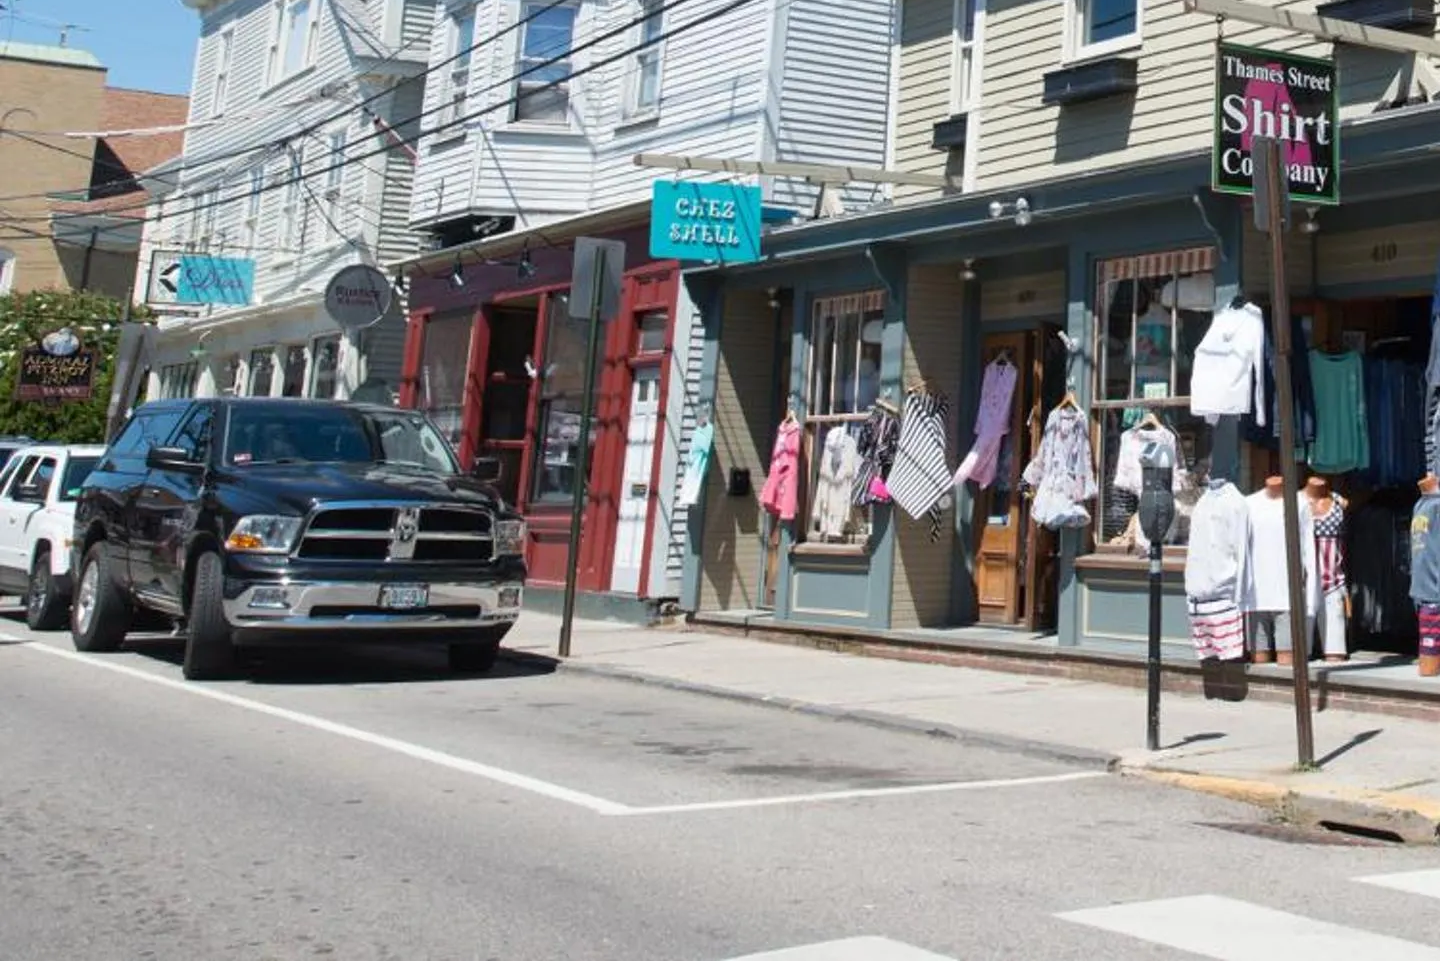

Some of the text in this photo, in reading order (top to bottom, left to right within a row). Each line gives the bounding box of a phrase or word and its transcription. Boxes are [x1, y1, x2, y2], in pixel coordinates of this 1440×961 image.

[1223, 55, 1331, 92] Thames Street
[1222, 94, 1331, 146] Shirt
[1222, 147, 1329, 192] Coany
[675, 197, 736, 219] CHEZ
[669, 222, 741, 246] SHELL
